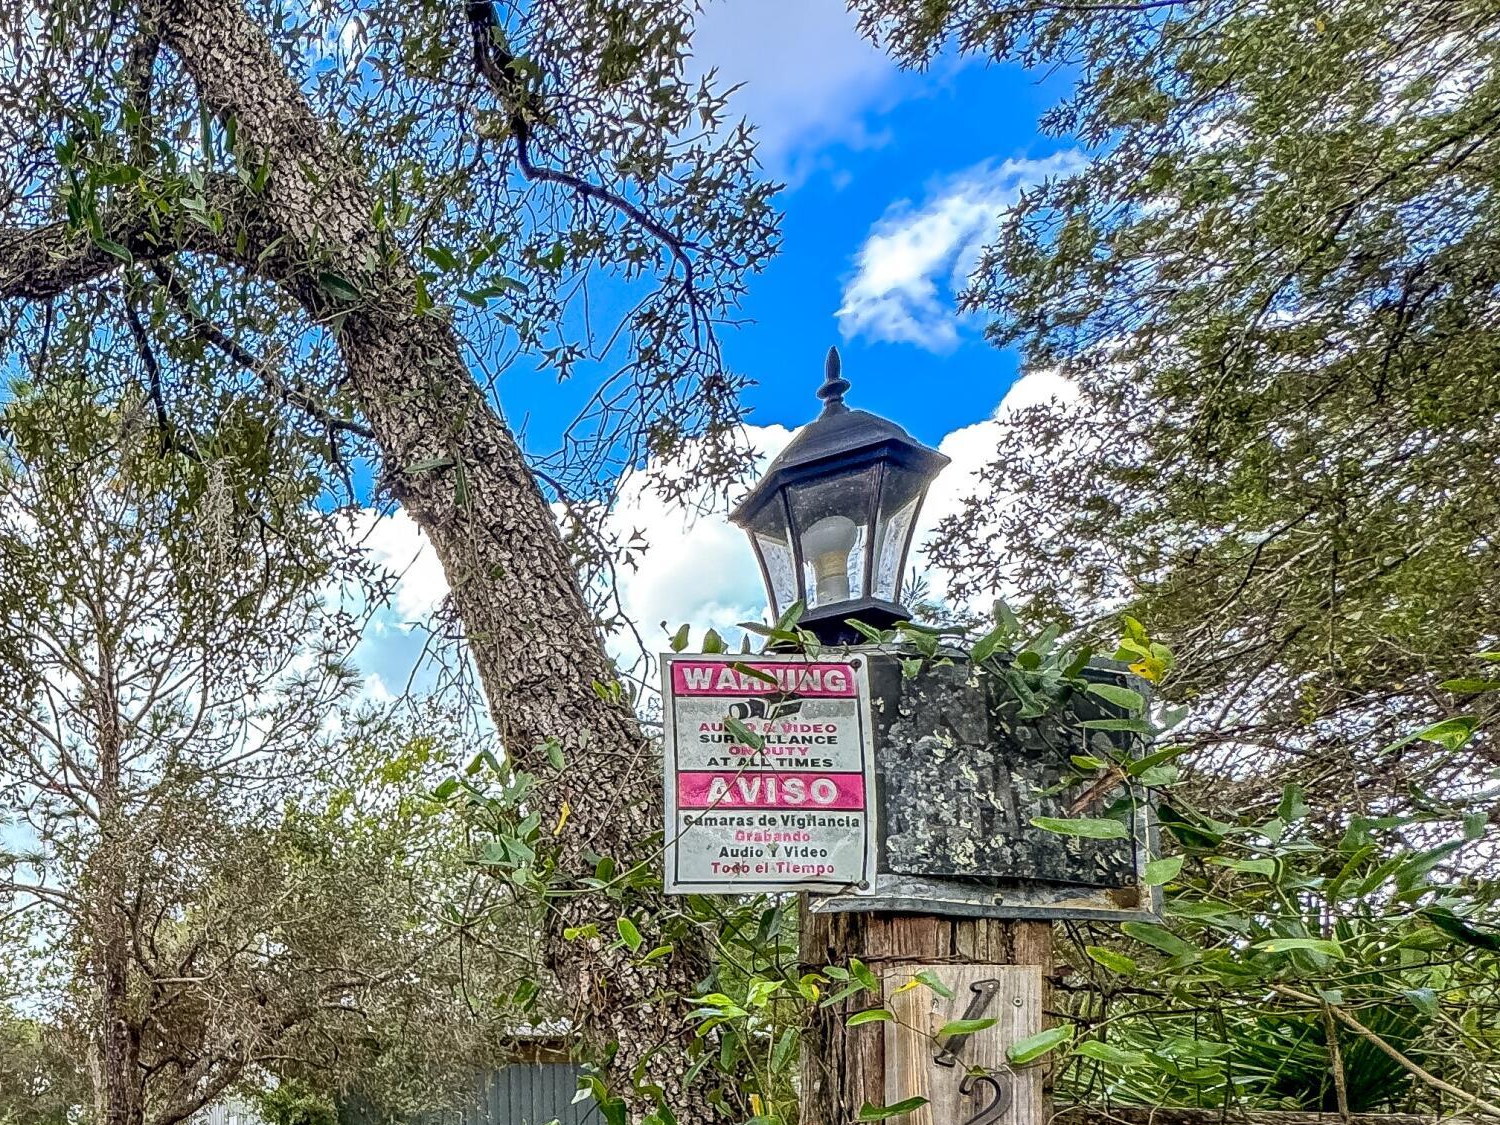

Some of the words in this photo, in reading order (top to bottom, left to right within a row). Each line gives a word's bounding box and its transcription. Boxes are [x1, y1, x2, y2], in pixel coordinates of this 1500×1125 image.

[698, 722, 757, 733] AUO
[763, 722, 777, 733] &
[781, 722, 838, 733] VIDEO
[699, 734, 839, 745] SURLLANCE
[707, 757, 731, 766] AT
[737, 757, 771, 767] ALL
[777, 758, 834, 768] TIMES
[706, 776, 838, 805] AVISO
[758, 815, 777, 827] de
[780, 814, 860, 829] Vigilancia
[734, 830, 811, 842] Grabando
[719, 846, 764, 858] Audio
[784, 846, 828, 858] Video
[711, 862, 750, 874] Todo
[755, 862, 769, 874] el
[776, 862, 835, 877] Tiempo
